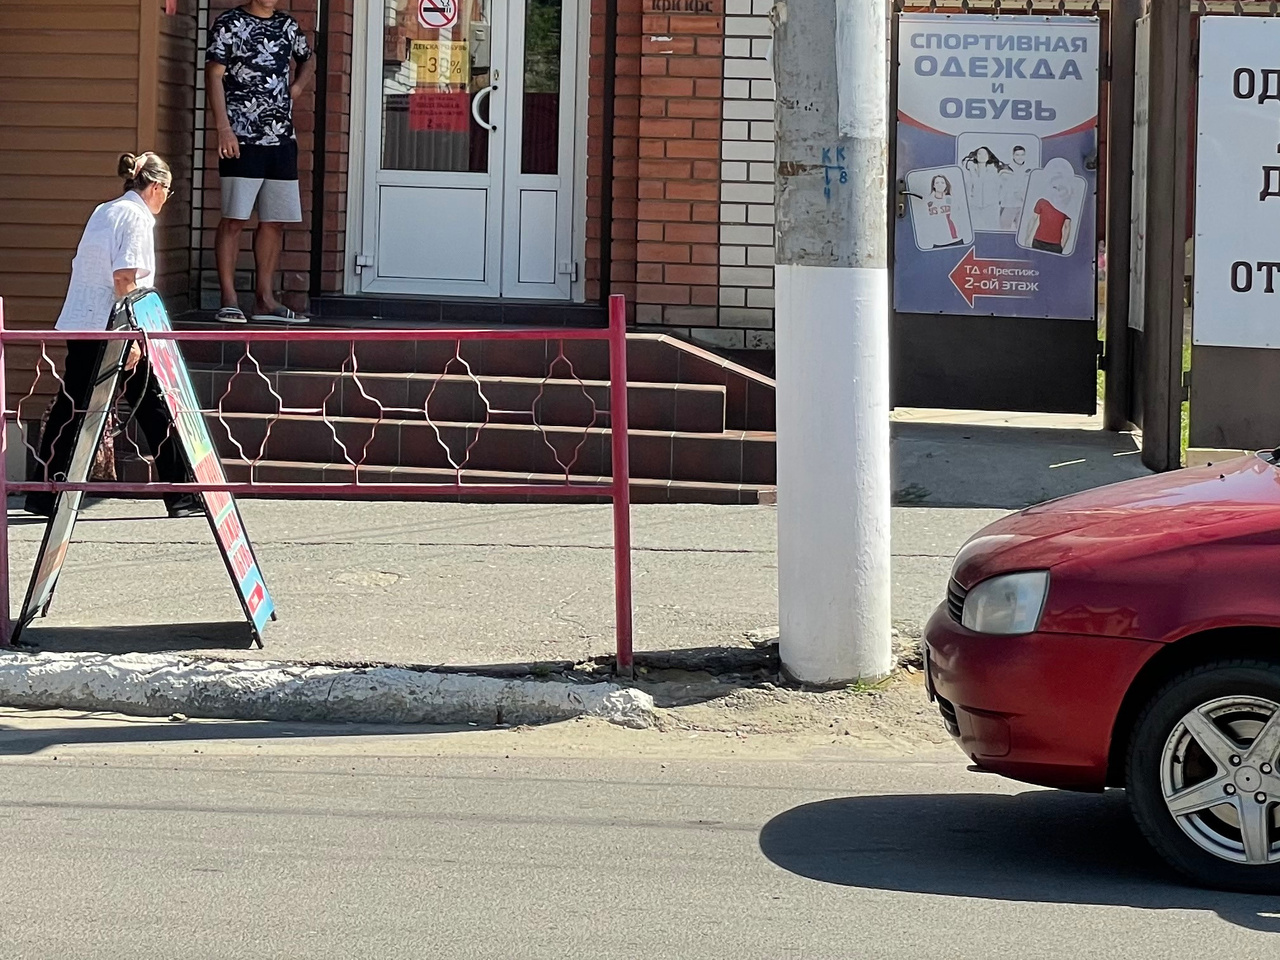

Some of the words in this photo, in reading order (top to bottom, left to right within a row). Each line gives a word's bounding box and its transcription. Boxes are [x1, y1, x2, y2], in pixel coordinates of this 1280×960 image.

[910, 33, 1087, 53] СПОРТИВНАЯ
[914, 55, 1082, 80] ОДЕЖДА
[939, 97, 1057, 121] ОБУВЬ
[964, 265, 980, 274] ТД
[983, 266, 1040, 277] «Престиж»
[964, 277, 999, 290] 2-ой
[1002, 280, 1039, 291] этаж
